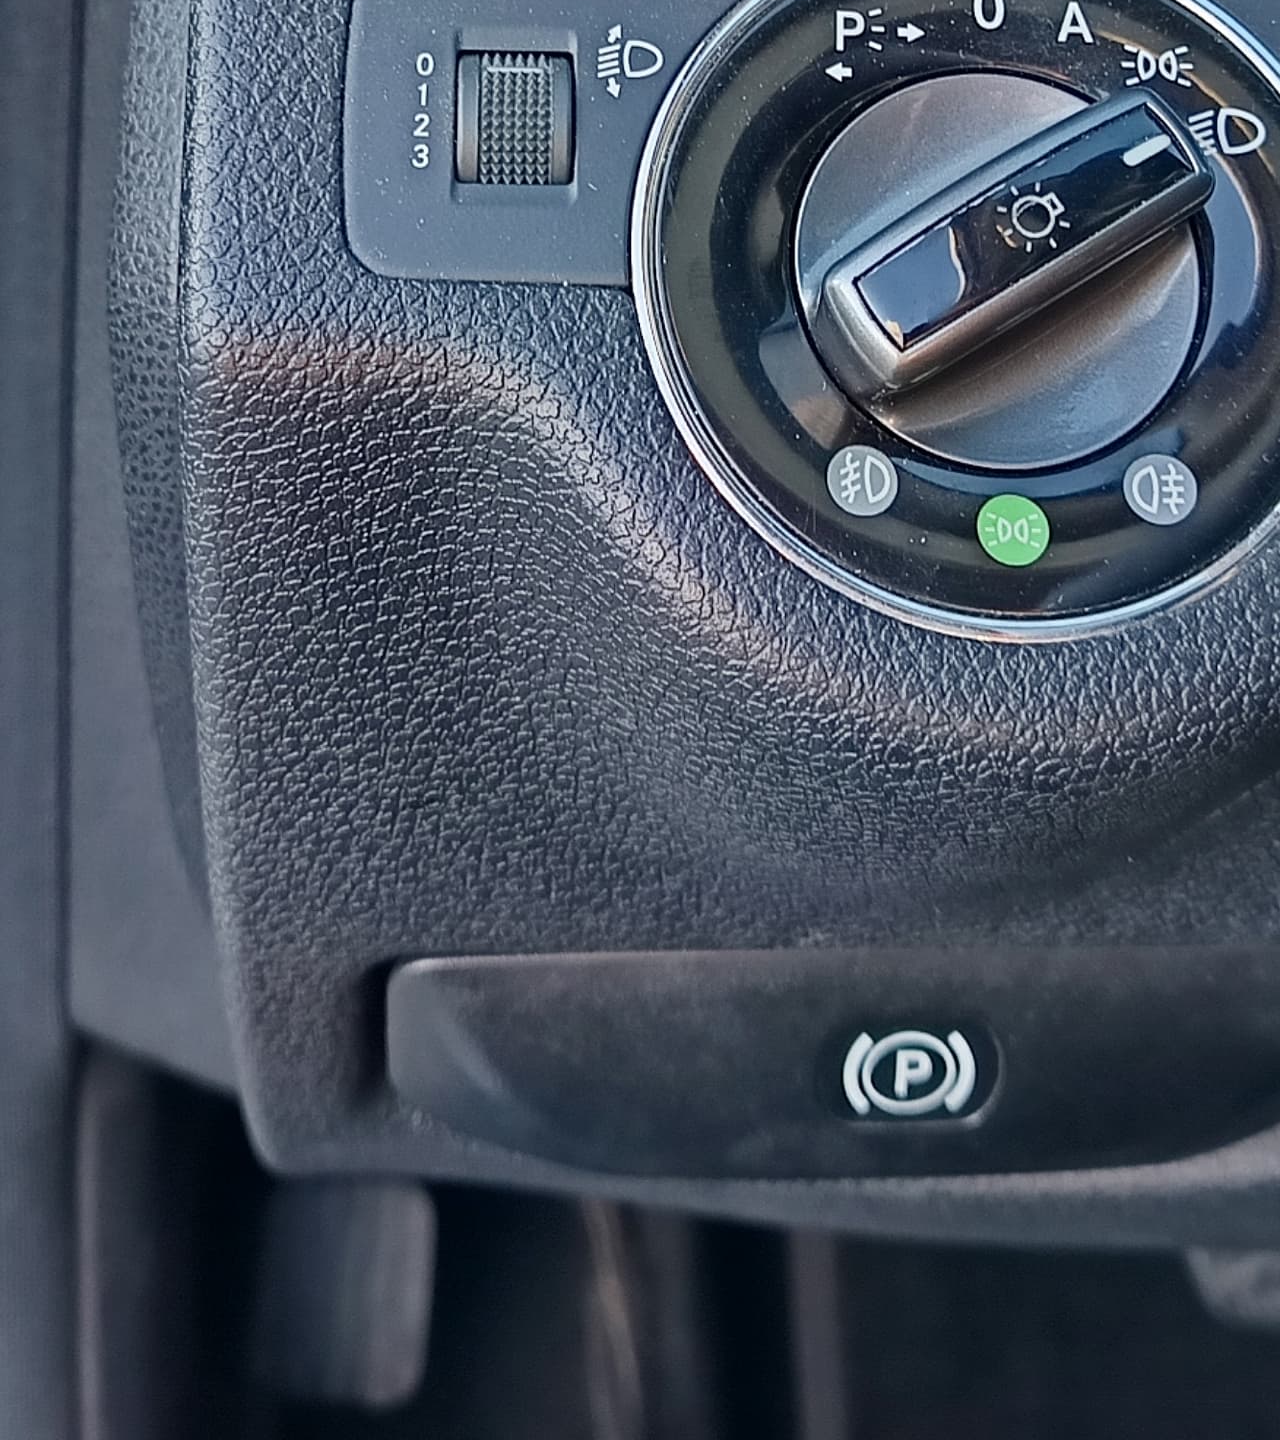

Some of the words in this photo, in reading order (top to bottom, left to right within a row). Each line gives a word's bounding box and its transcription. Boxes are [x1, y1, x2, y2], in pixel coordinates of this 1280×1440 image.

[836, 11, 865, 51] P
[1058, 2, 1094, 43] A
[413, 114, 430, 137] 2
[411, 143, 430, 168] 3
[894, 1049, 933, 1098] P
